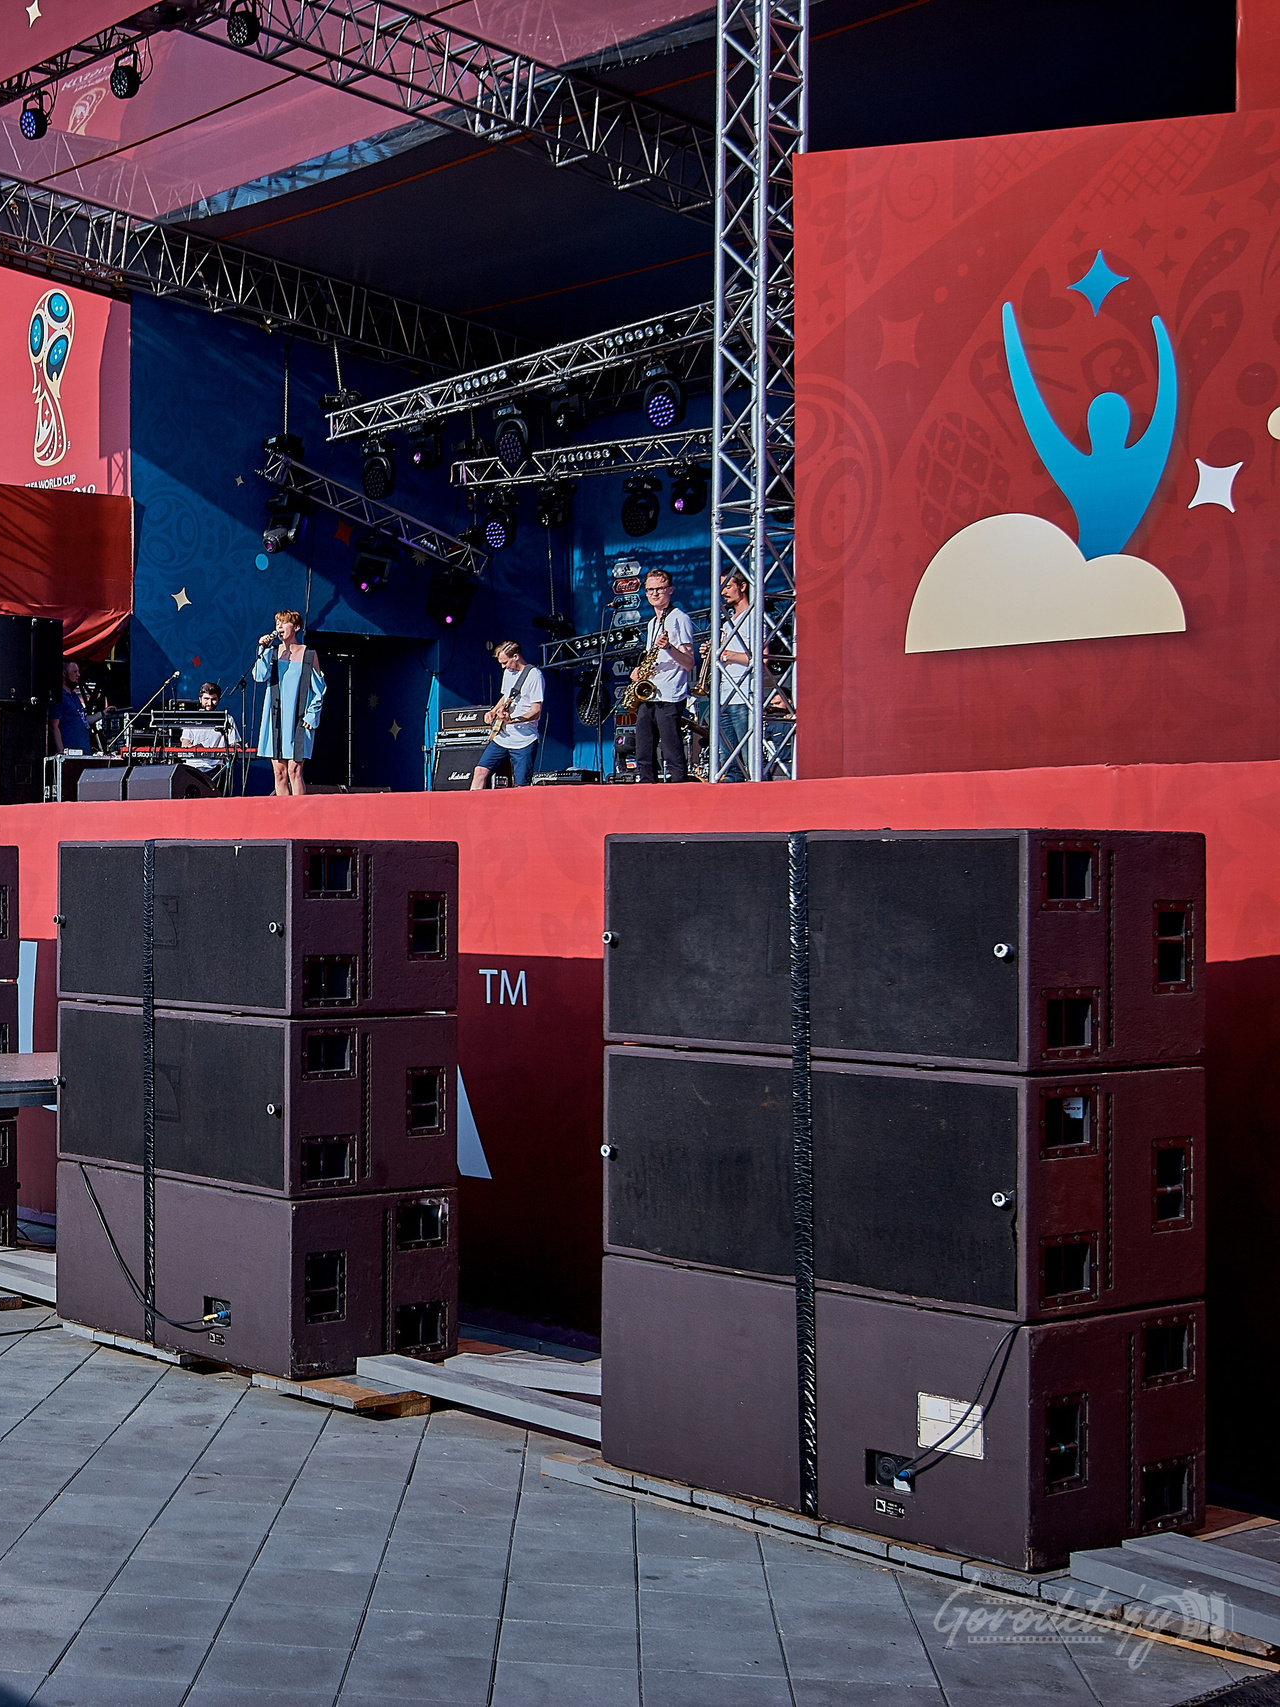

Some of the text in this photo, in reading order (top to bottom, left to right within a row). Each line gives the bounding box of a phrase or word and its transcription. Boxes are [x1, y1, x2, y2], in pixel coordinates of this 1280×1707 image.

[38, 477, 62, 489] WORLD
[63, 474, 76, 486] CUP
[478, 968, 527, 1006] TM
